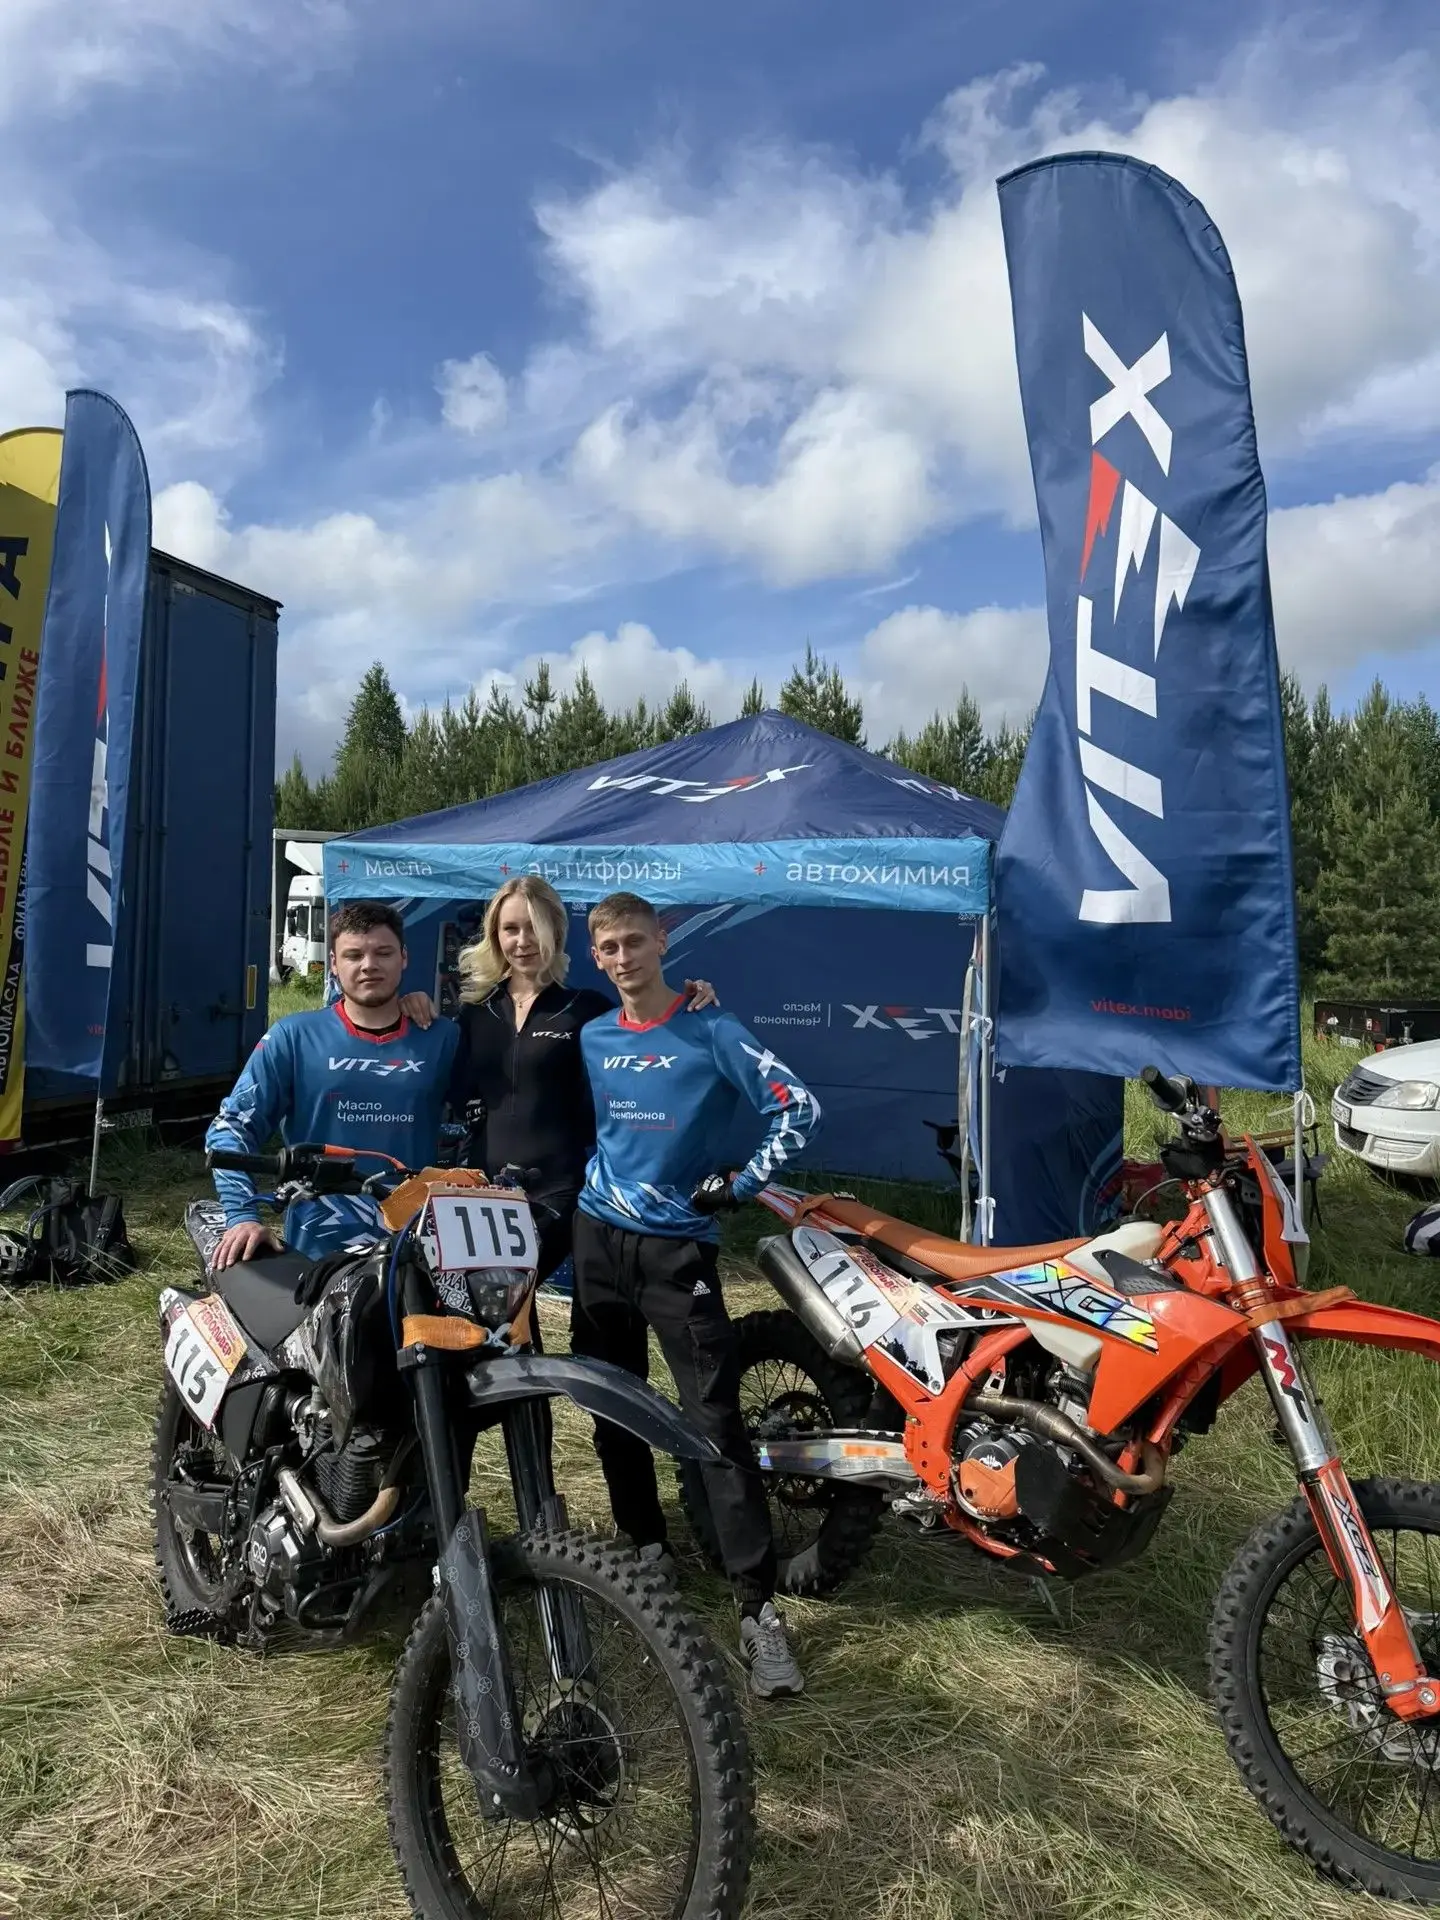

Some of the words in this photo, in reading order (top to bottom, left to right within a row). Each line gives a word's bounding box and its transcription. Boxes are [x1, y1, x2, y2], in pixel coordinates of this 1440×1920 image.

[6, 646, 39, 759] БЛИЖЕ
[528, 856, 682, 885] антифризы
[785, 862, 970, 887] автохимия
[1089, 997, 1192, 1021] vitex.mobi
[337, 1100, 382, 1111] Масло
[609, 1099, 637, 1110] Масло
[609, 1111, 666, 1121] Чемпионов
[337, 1112, 415, 1124] Чемпионов
[454, 1206, 526, 1258] 115
[819, 1259, 881, 1329] 116
[171, 1328, 218, 1404] 115
